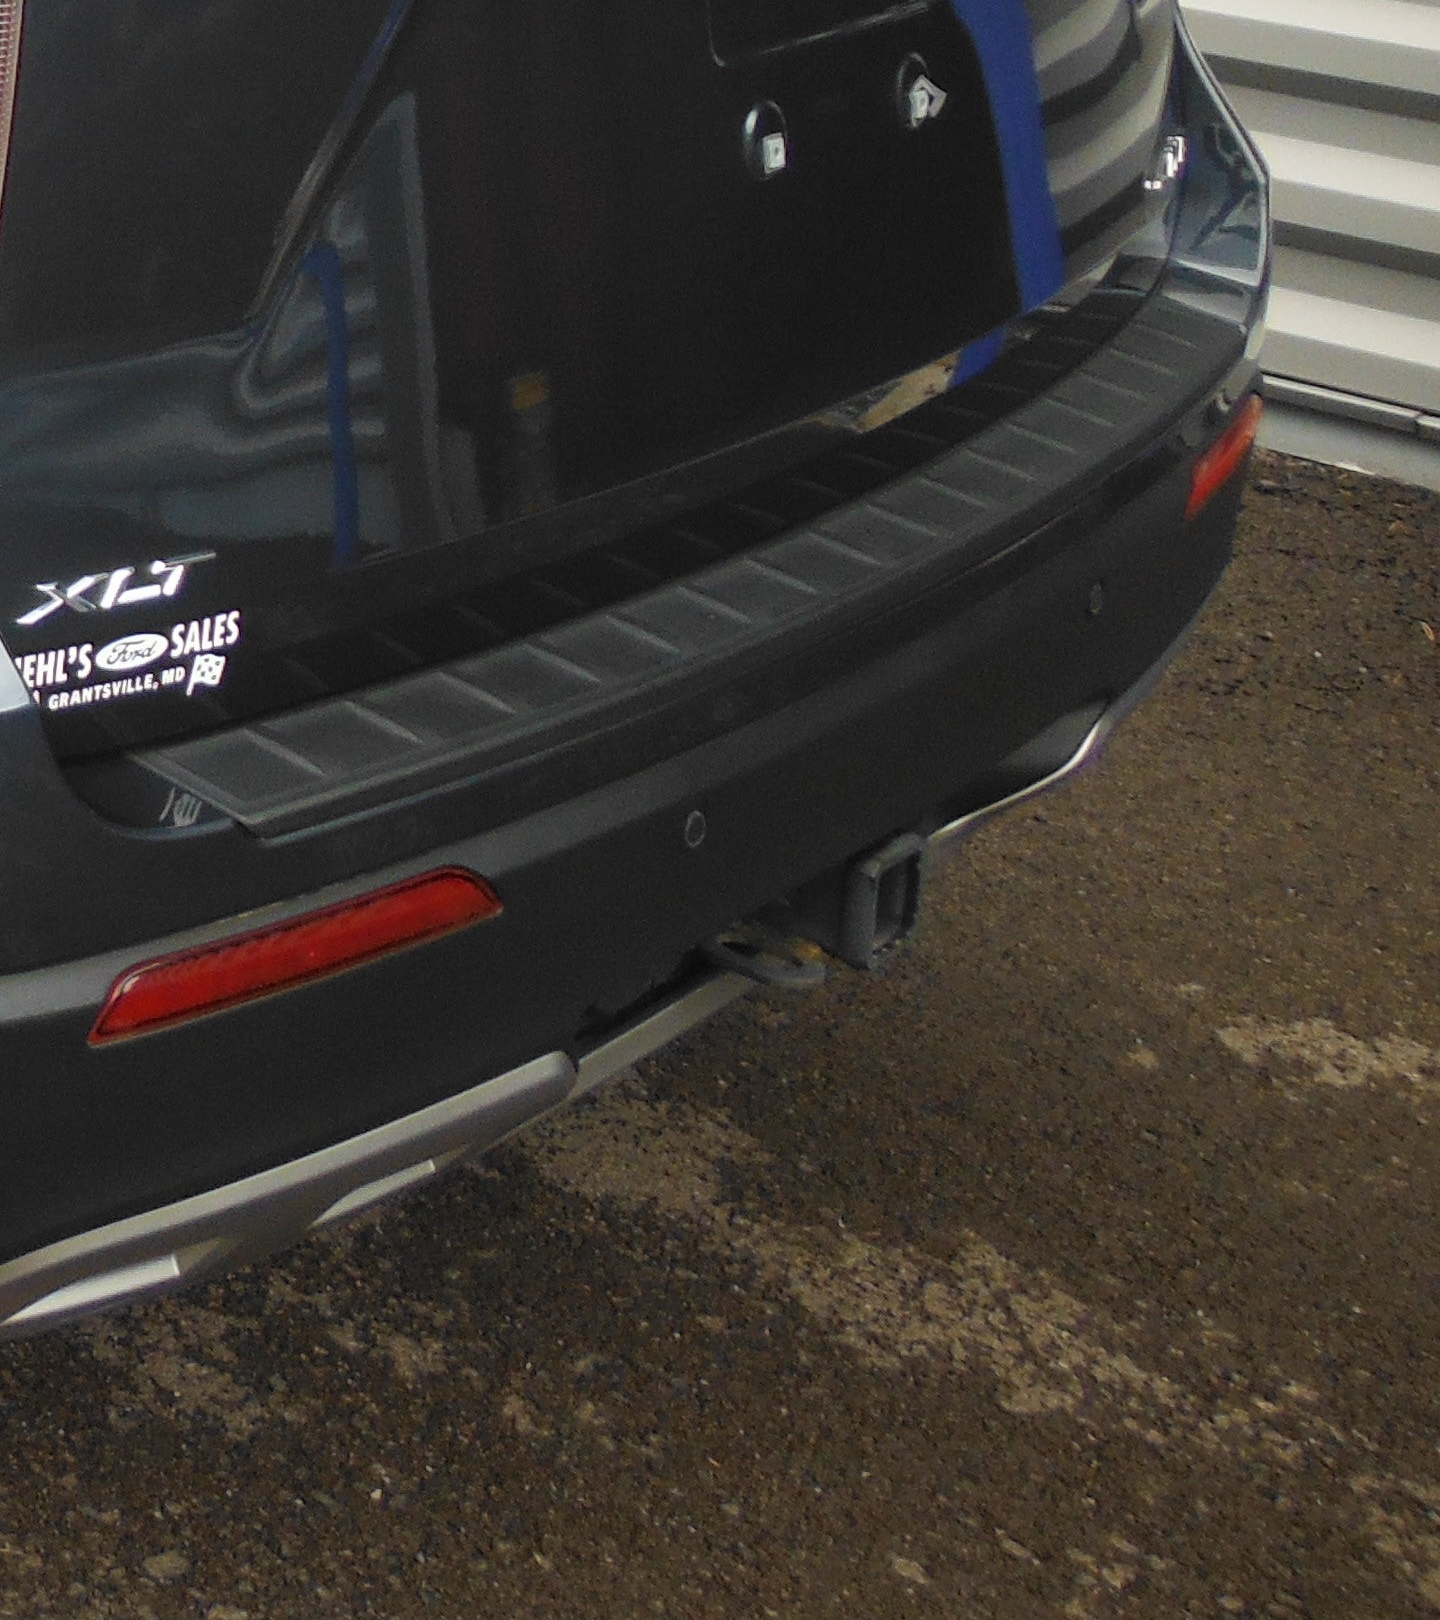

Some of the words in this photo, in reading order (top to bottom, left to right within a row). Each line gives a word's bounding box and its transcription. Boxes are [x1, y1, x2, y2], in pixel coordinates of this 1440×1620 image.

[15, 549, 217, 625] XLT
[104, 637, 160, 666] Ford
[169, 610, 241, 659] SALES
[160, 664, 187, 686] MD
